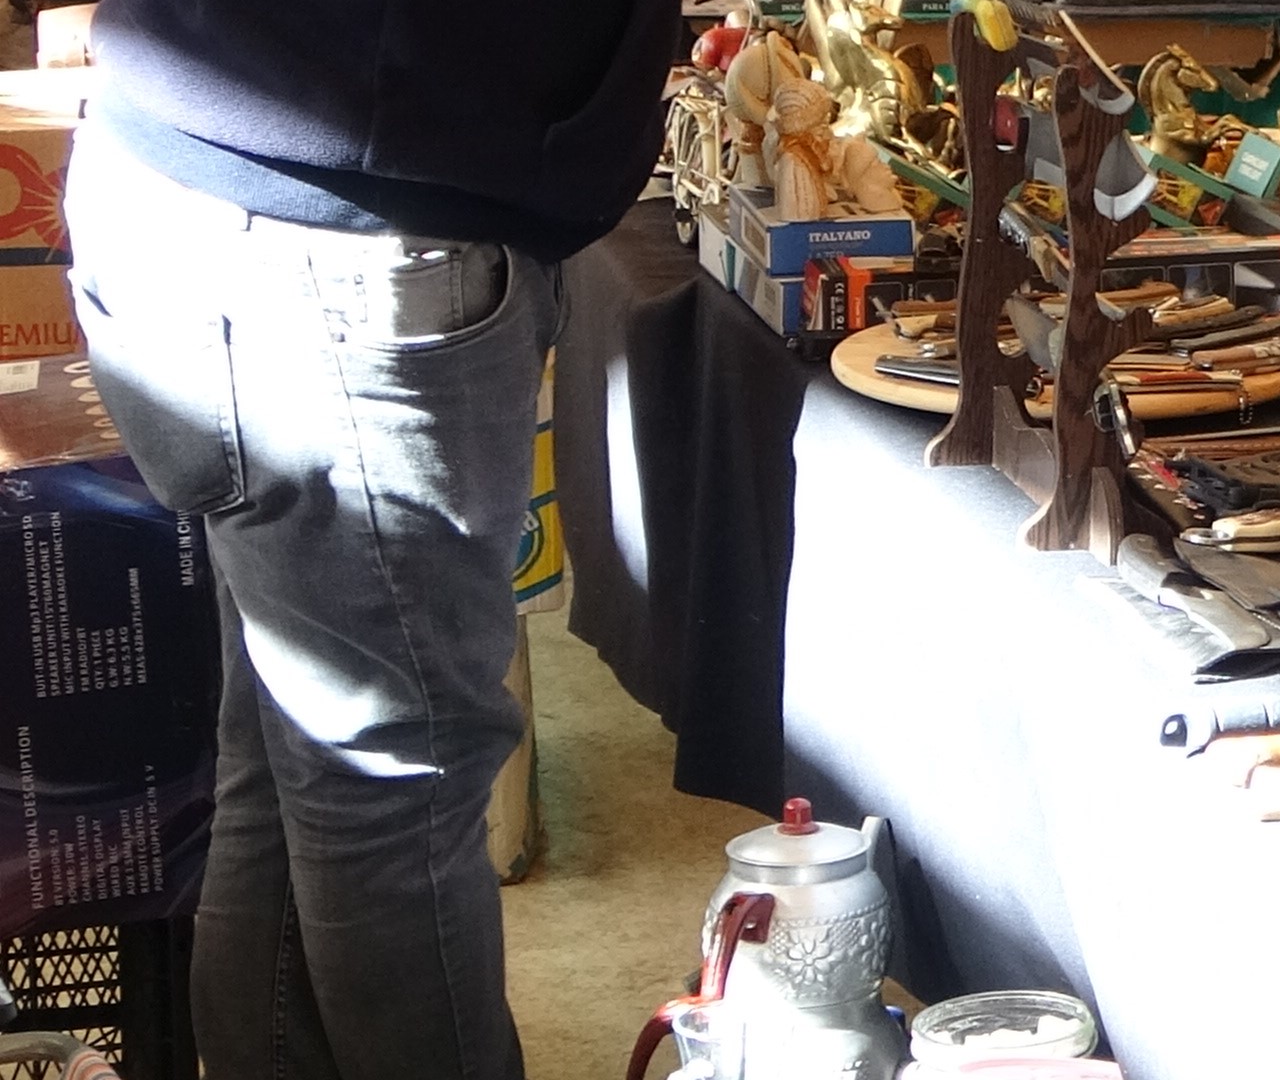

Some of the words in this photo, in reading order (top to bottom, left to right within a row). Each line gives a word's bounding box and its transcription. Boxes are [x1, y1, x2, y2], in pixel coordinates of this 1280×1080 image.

[809, 230, 871, 243] ITALYANO
[0, 322, 79, 347] EMIU
[51, 512, 64, 564] FUNCTION
[178, 536, 191, 548] IN
[180, 551, 194, 586] MADE
[55, 566, 68, 612] KARAOKE
[59, 615, 70, 640] WITH
[106, 628, 115, 644] KG
[120, 627, 129, 642] KG
[31, 636, 43, 656] USB
[91, 631, 101, 656] PIECE
[60, 643, 73, 673] INPUT
[48, 651, 61, 696] SPEAKER
[63, 675, 74, 694] MIC
[80, 676, 90, 691] FM
[18, 726, 37, 817] DESCRIPTION
[92, 819, 104, 859] DISPLAY
[135, 805, 146, 851] CONTROL
[27, 820, 44, 909] FUNCTIONAL
[108, 844, 118, 863] MIC
[95, 862, 107, 899] DIGITAL
[126, 875, 136, 895] AUX
[138, 854, 149, 893] REMOTE
[153, 857, 164, 891] POWER
